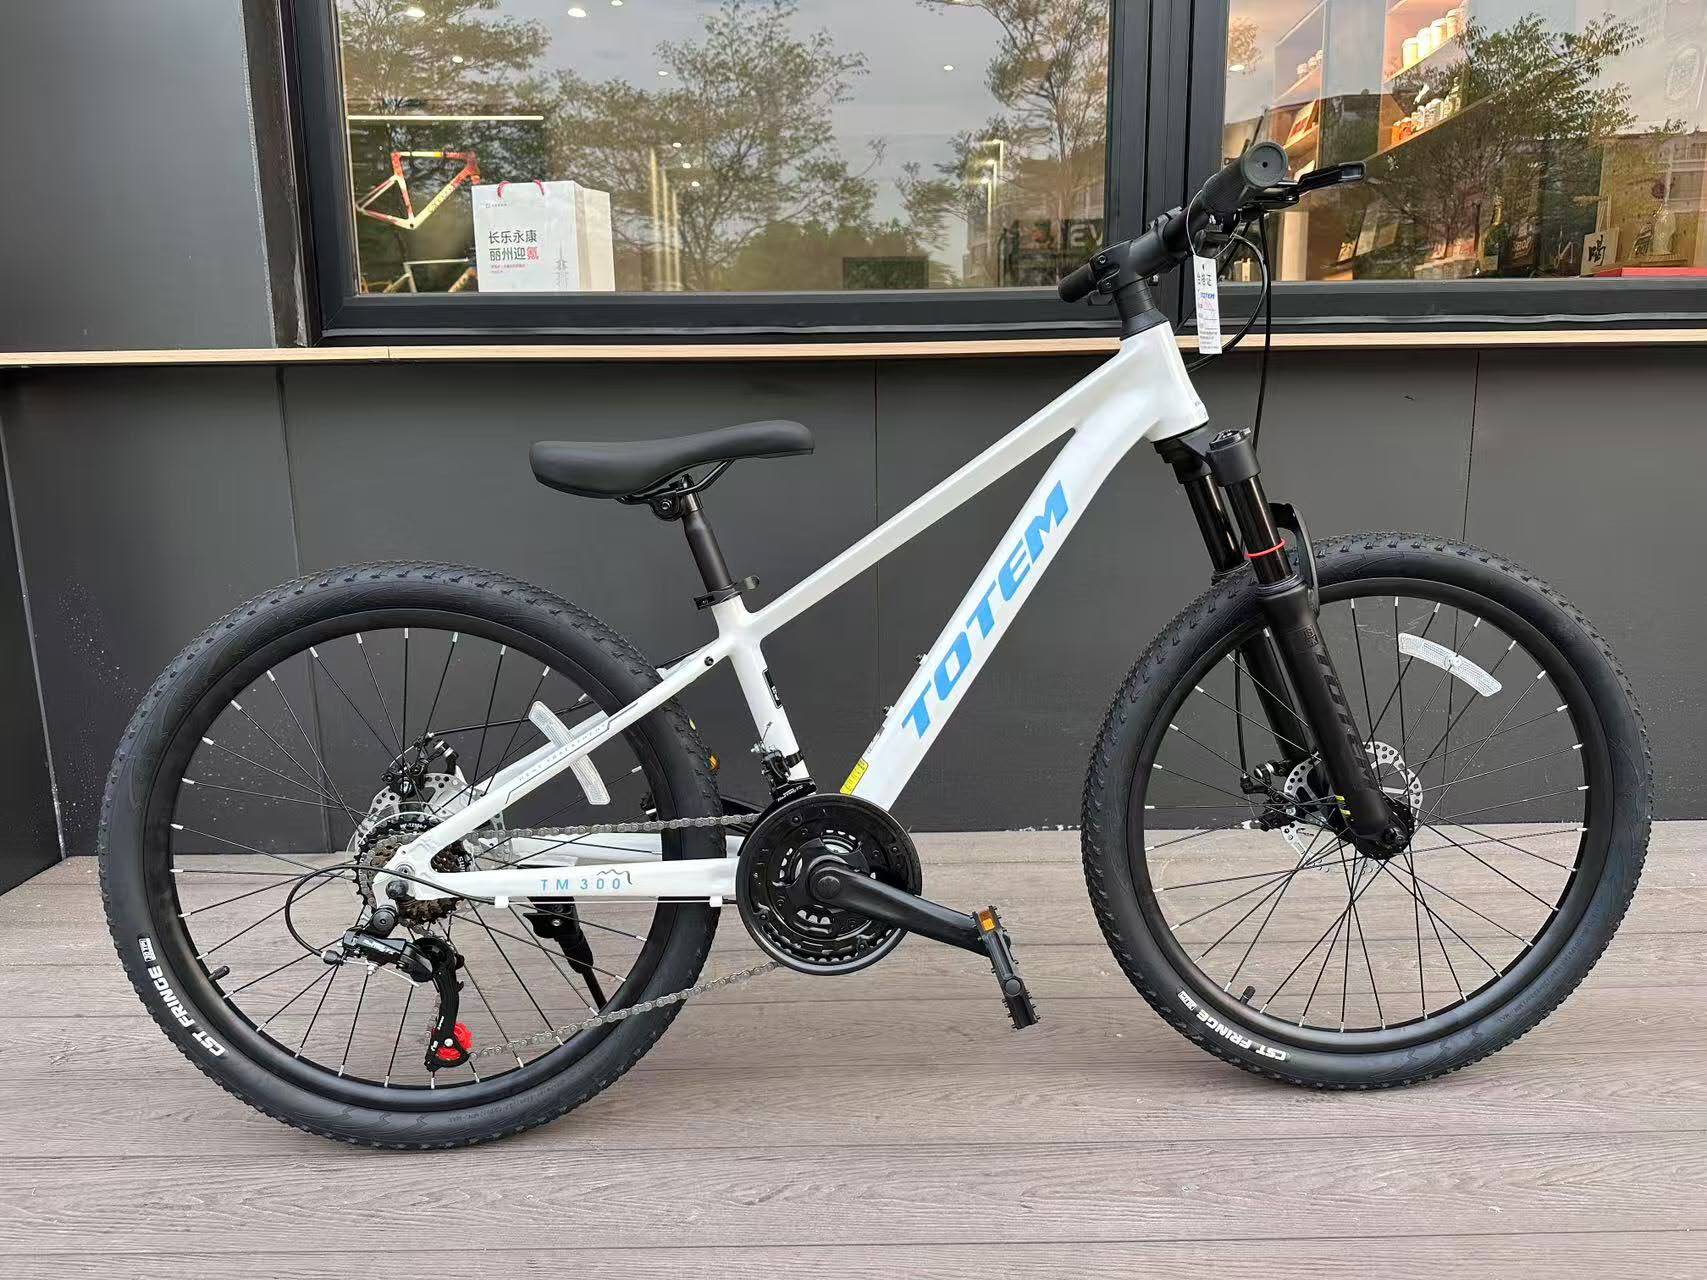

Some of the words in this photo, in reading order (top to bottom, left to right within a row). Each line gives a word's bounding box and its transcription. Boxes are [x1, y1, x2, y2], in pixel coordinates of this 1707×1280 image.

[489, 230, 537, 244] 长乐永康
[901, 480, 1069, 740] TOTEM
[541, 879, 569, 891] TM
[580, 878, 621, 890] 300
[147, 965, 196, 1028] FRINGE
[1196, 1008, 1253, 1049] FRINGE
[192, 1030, 226, 1056] CST
[1255, 1044, 1287, 1061] CST
